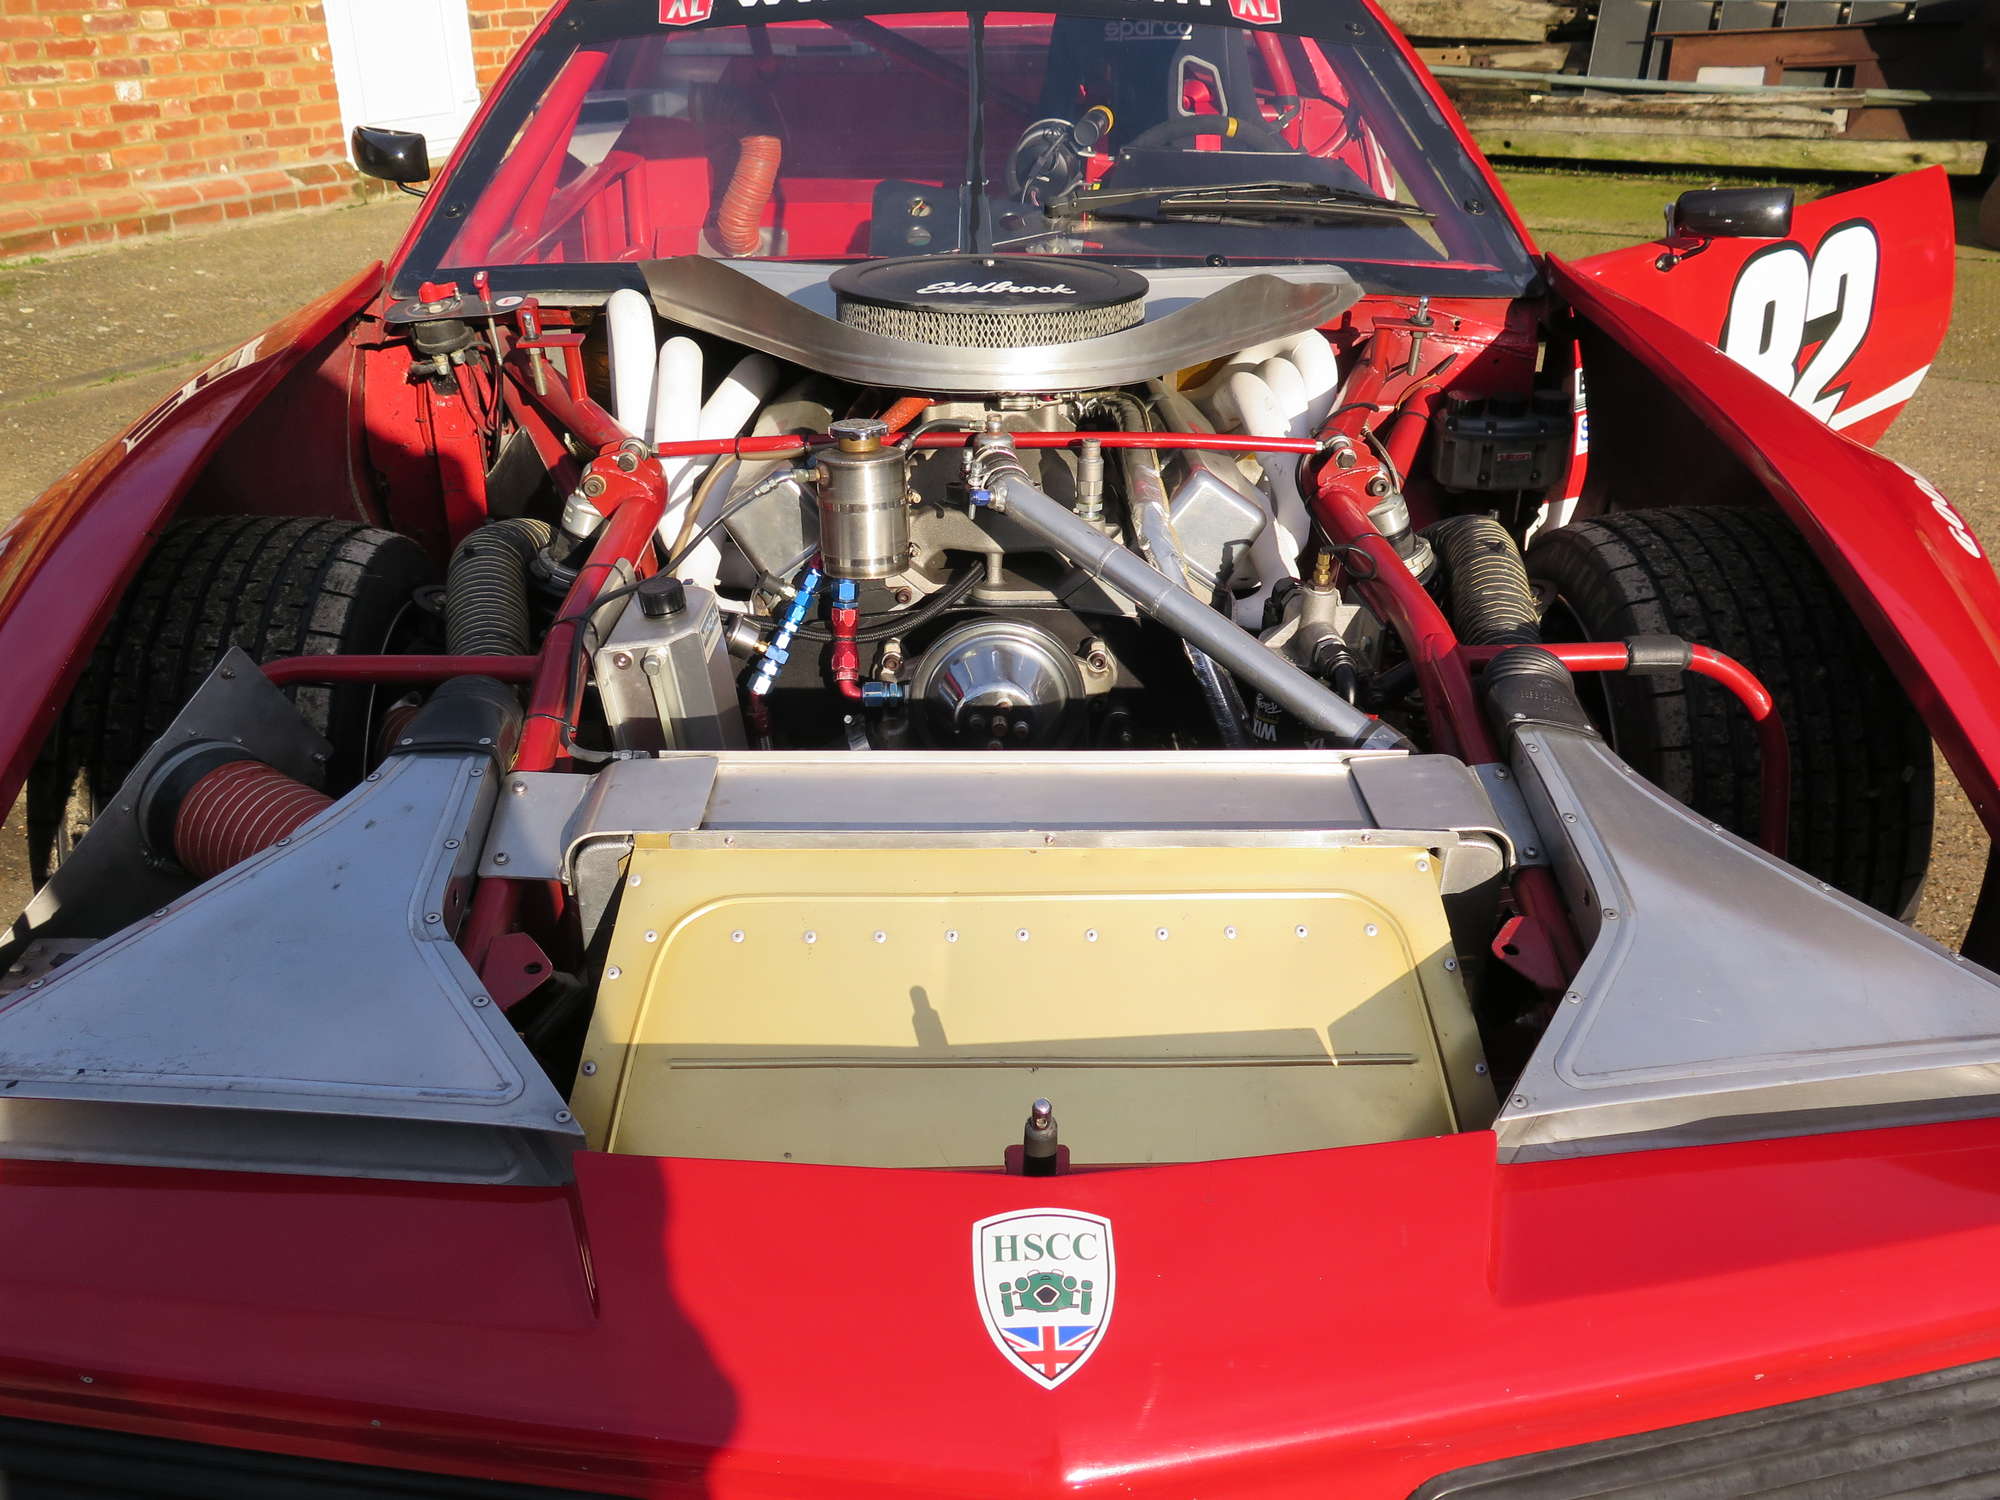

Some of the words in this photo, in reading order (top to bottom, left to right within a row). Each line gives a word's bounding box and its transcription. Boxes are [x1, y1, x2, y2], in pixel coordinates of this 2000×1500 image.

[1104, 19, 1193, 41] sparco
[916, 281, 1077, 294] Edelbrock
[1720, 218, 1880, 425] 82
[991, 1232, 1099, 1263] HSCC
